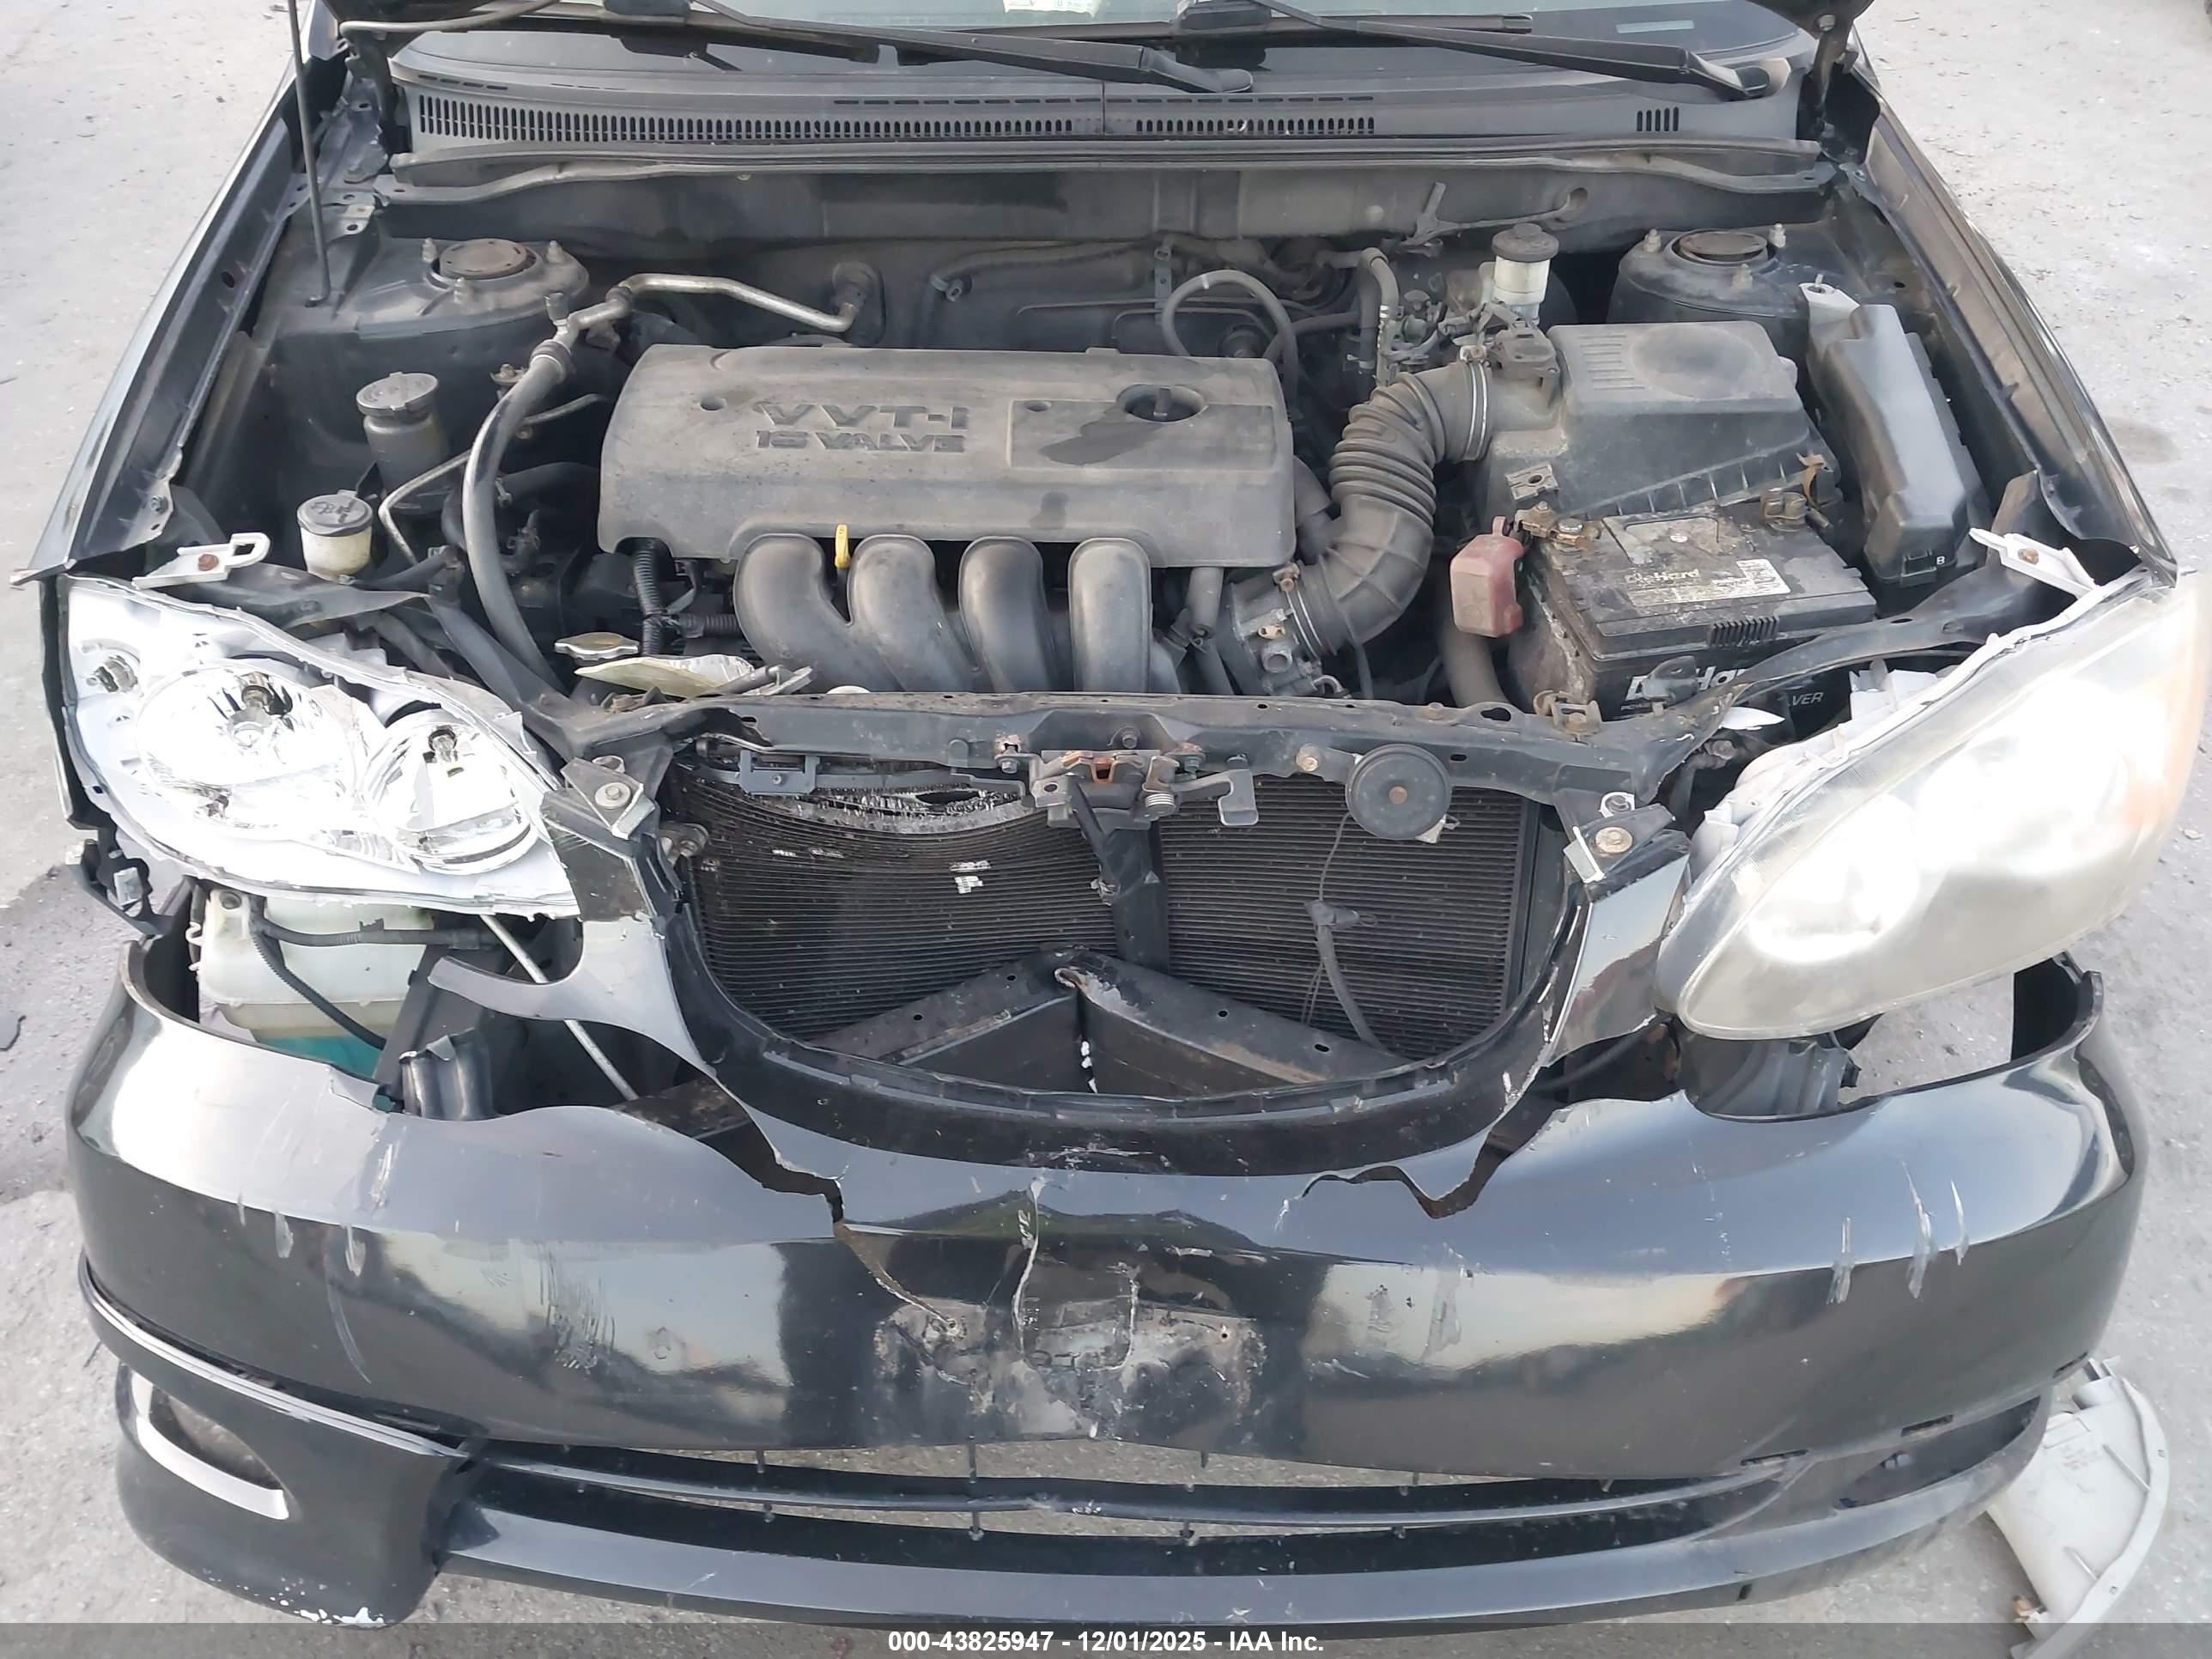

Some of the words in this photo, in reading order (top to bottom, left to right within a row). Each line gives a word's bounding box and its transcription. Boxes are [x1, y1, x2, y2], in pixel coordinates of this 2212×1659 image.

[814, 431, 966, 453] VALVE
[1936, 556, 1946, 565] B
[1788, 691, 1824, 707] VER
